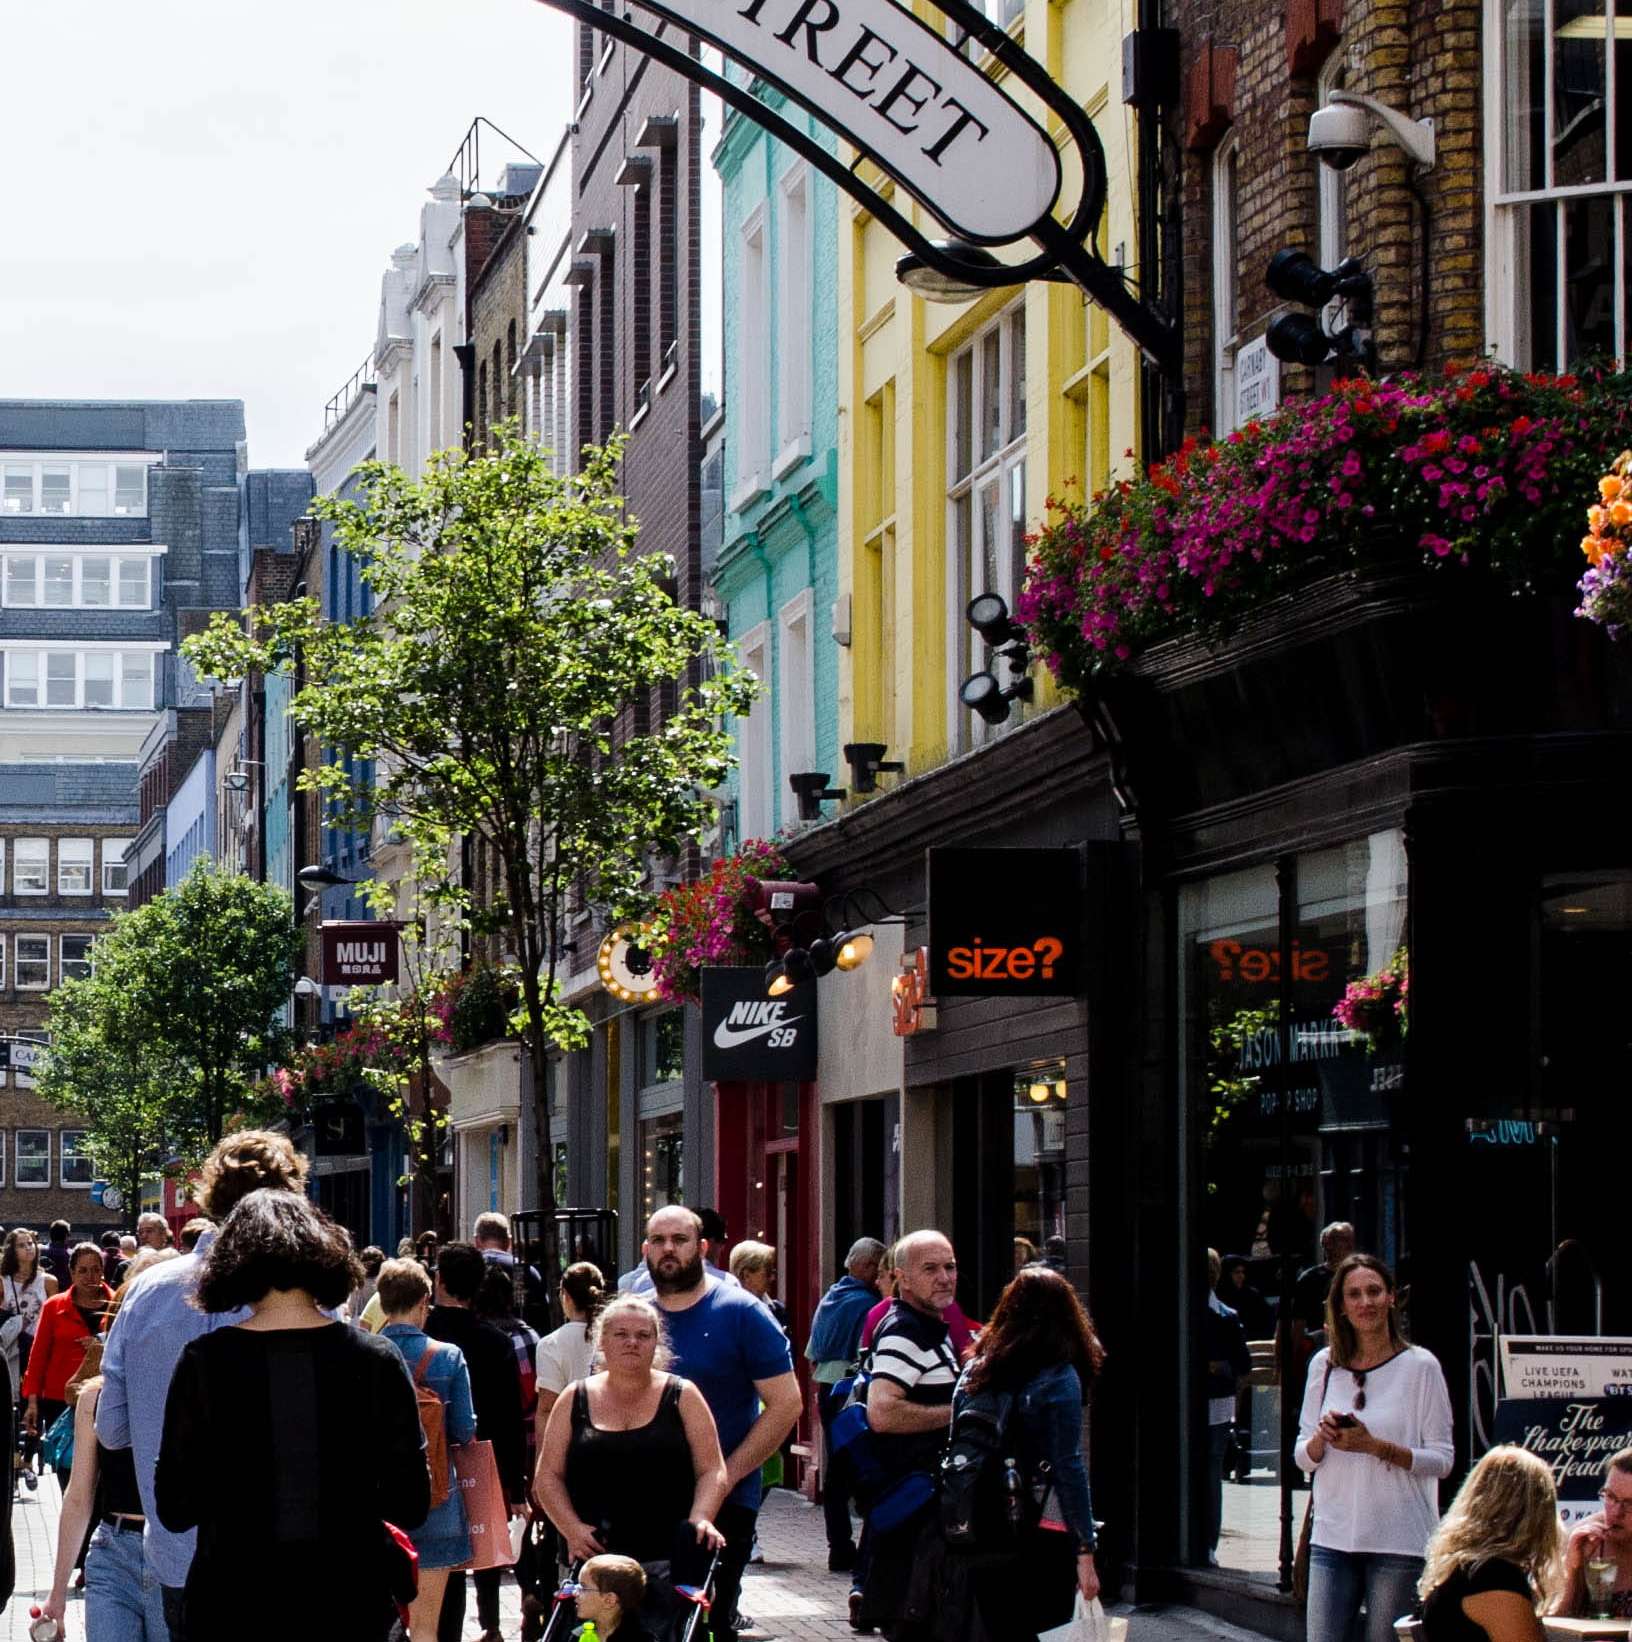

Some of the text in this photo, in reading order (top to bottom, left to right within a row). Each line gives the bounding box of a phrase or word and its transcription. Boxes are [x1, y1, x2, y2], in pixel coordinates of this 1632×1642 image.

[336, 942, 386, 963] MUJI
[947, 937, 1063, 979] size?
[728, 1001, 788, 1025] NIKE
[767, 1028, 798, 1048] SB
[1525, 1367, 1579, 1377] LIVE UEFA
[1521, 1378, 1586, 1389] CHAMPIONS
[1560, 1404, 1604, 1432] The
